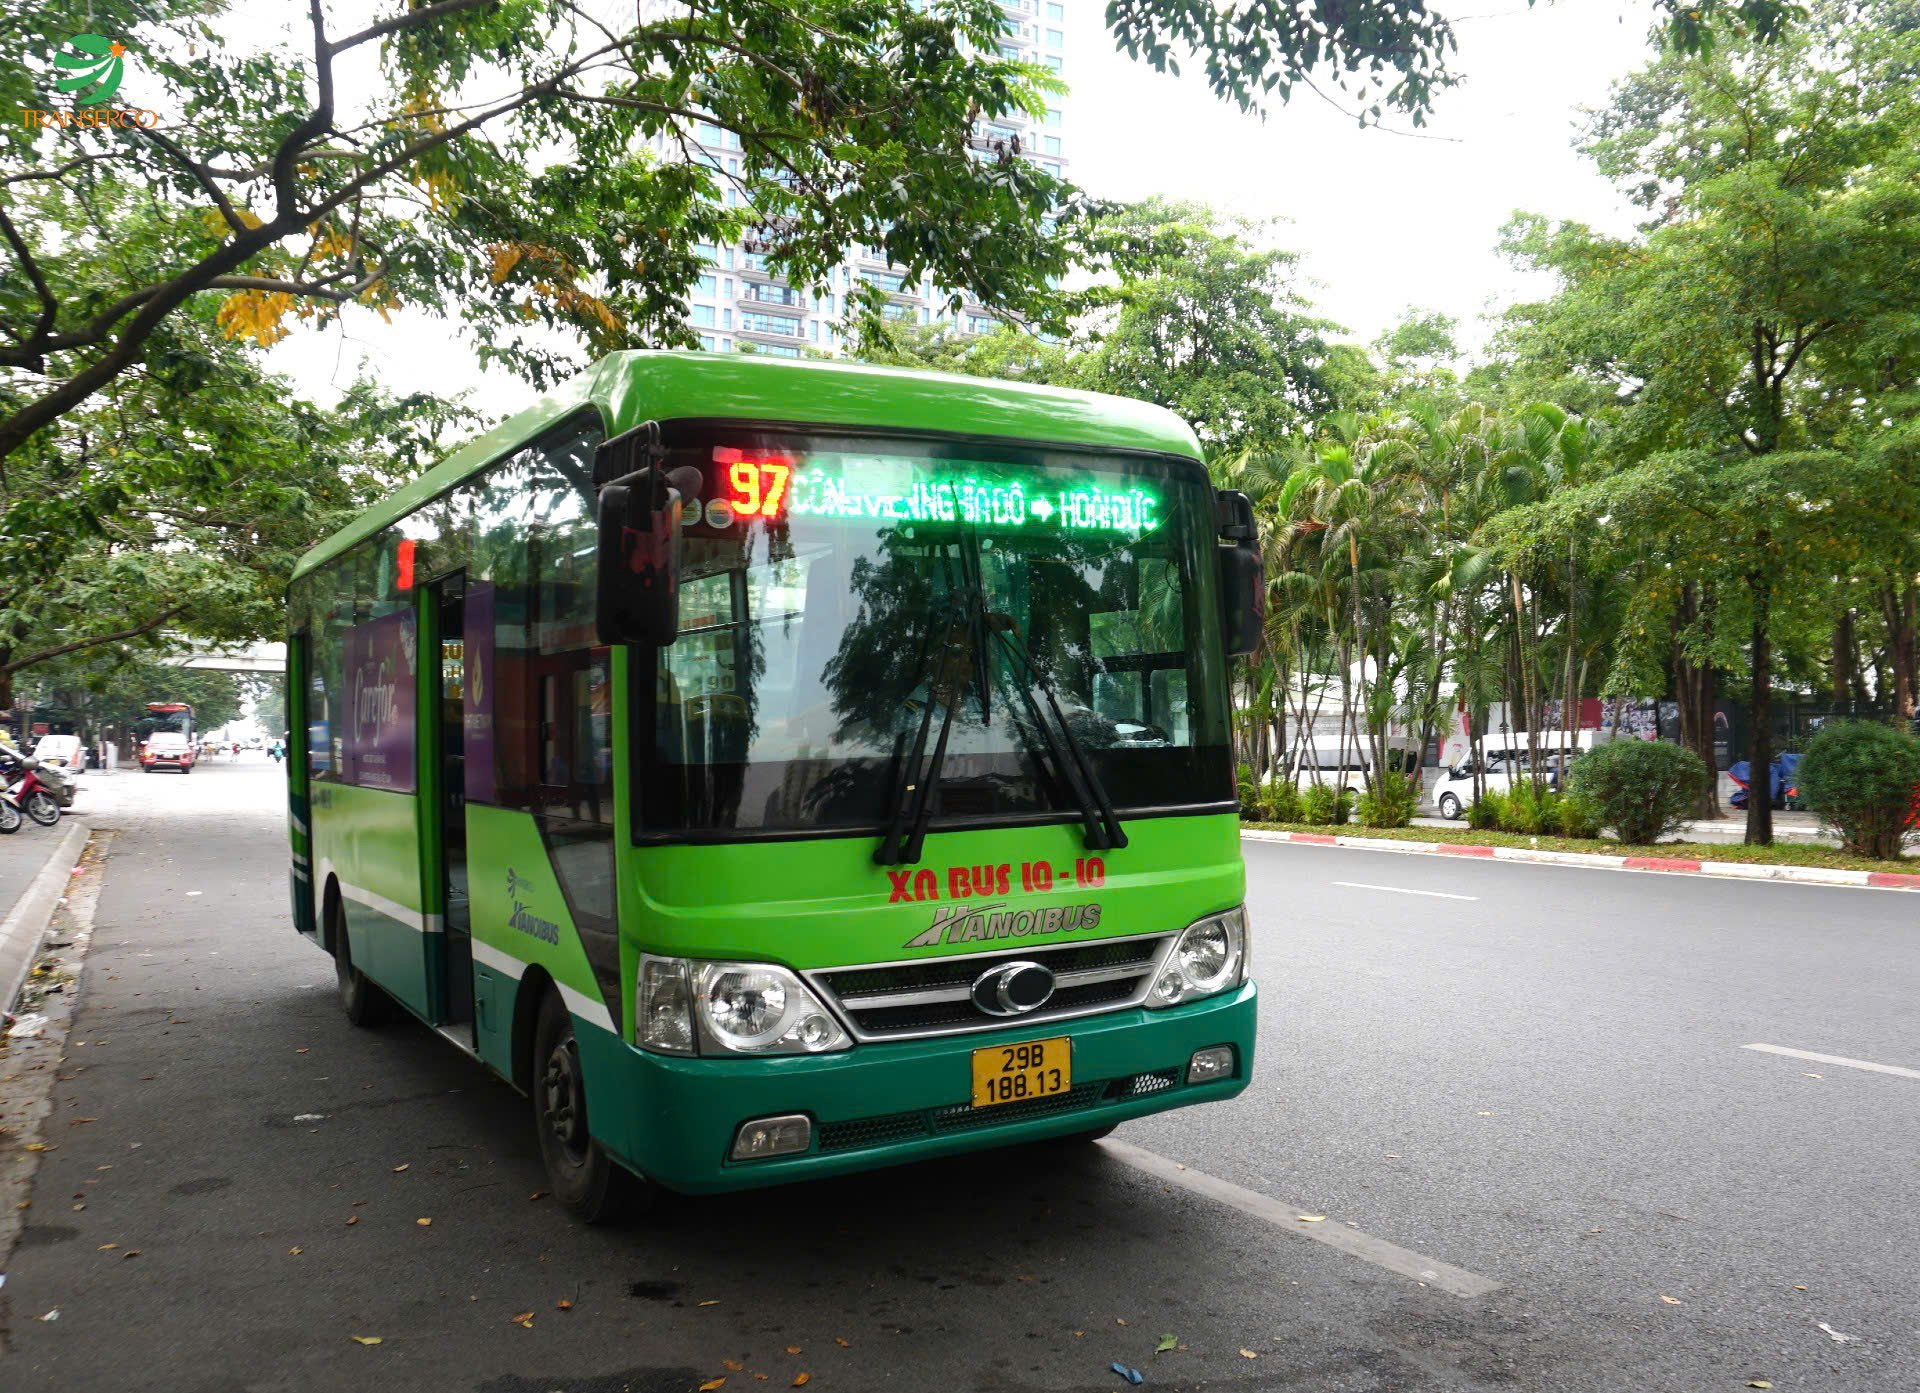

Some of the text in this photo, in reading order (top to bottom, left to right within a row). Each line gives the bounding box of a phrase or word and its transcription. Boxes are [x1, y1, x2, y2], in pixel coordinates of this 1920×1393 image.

[729, 462, 789, 516] 97
[1059, 486, 1110, 529] HOÀI
[1111, 488, 1157, 531] ĐỨC
[947, 863, 1011, 899] BUS
[902, 903, 1102, 949] HANOIBUS
[1001, 1044, 1045, 1073] 29B
[986, 1068, 1061, 1103] 188.13
